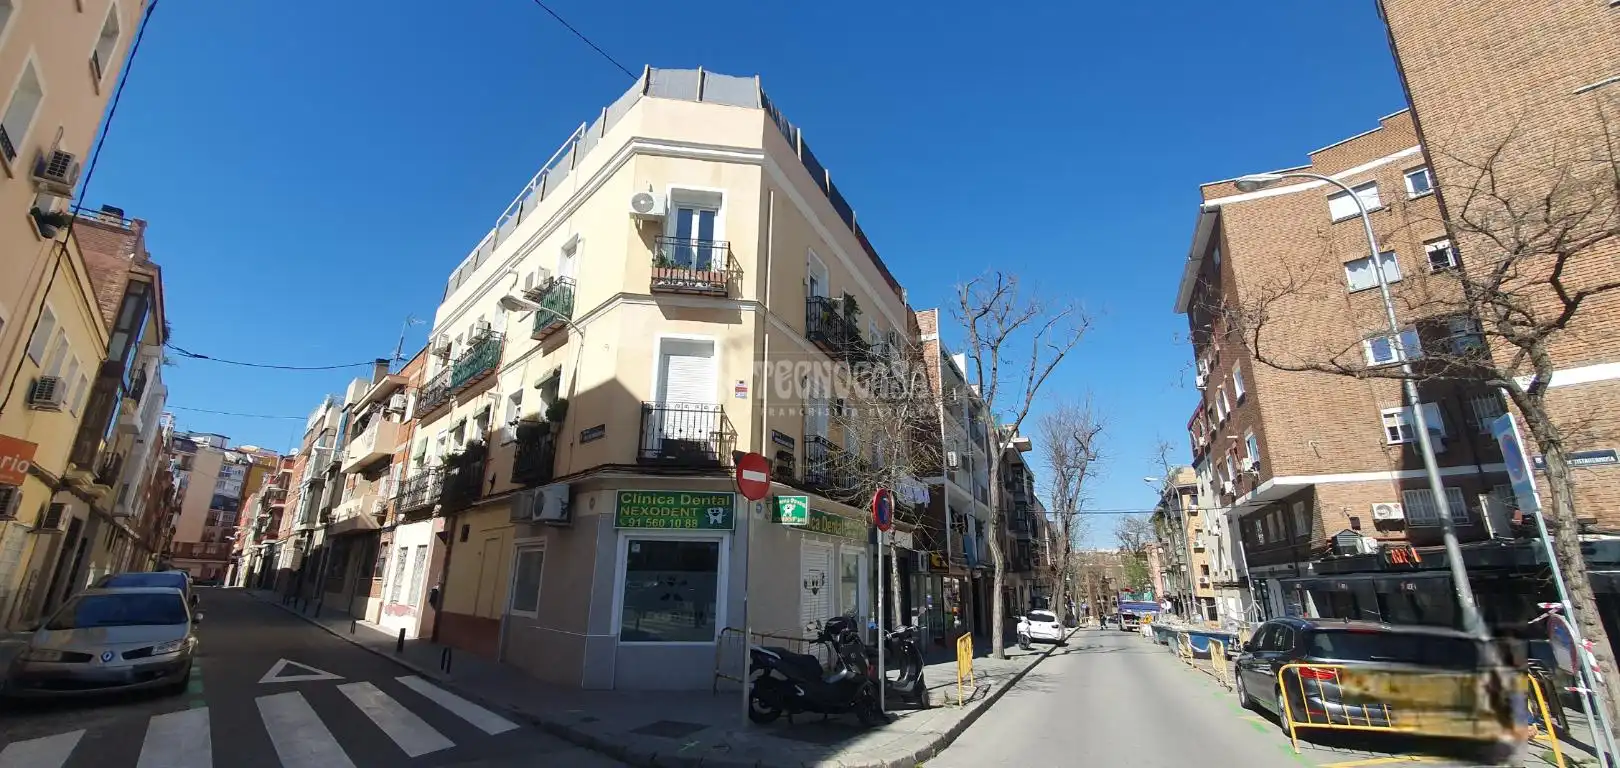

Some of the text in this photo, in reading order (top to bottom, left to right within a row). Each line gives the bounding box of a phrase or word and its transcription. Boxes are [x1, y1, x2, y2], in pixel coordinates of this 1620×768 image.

[0, 453, 30, 474] rio
[680, 494, 730, 506] Dental
[620, 506, 699, 517] NEXODENT
[628, 517, 698, 528] 91 560 10 88
